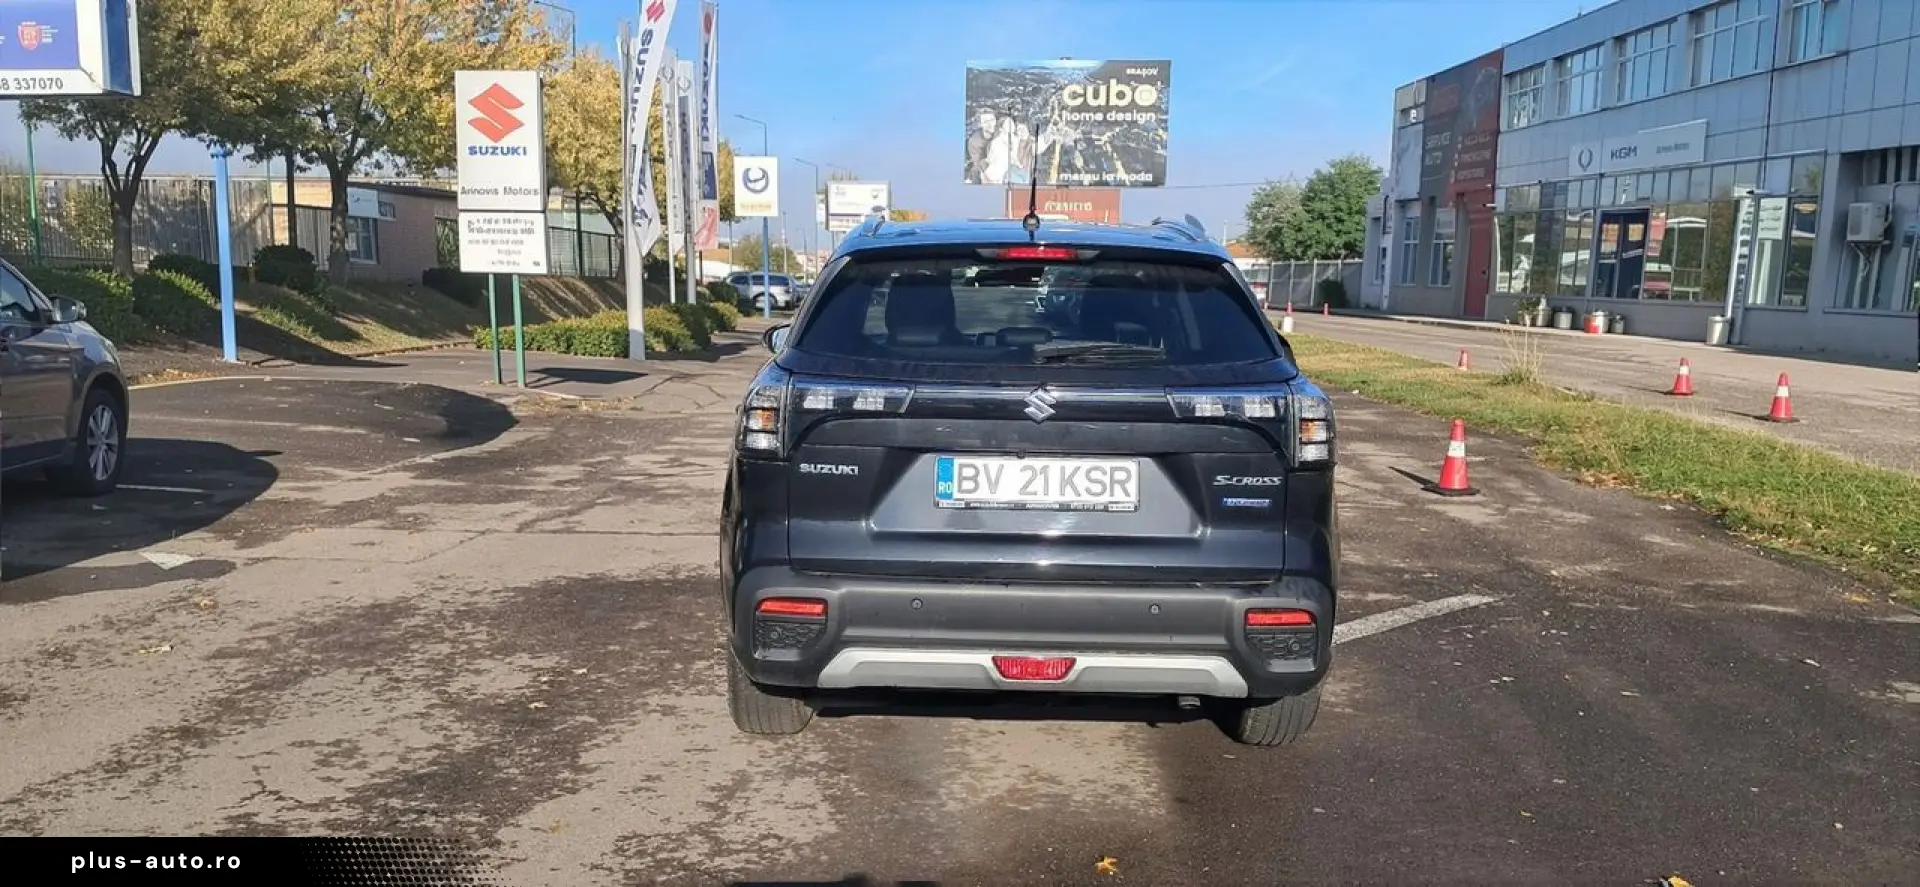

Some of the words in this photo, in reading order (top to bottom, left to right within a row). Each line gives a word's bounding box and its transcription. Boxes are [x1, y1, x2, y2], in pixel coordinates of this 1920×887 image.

[13, 77, 63, 90] 337070
[1063, 78, 1157, 107] cubo
[1061, 110, 1104, 122] home
[1106, 110, 1156, 123] design
[468, 145, 527, 156] SUZUKI
[1610, 145, 1638, 160] KGM
[503, 185, 540, 195] Motors
[799, 463, 859, 475] SUZUKI
[938, 482, 953, 494] RO
[956, 463, 1004, 495] BV
[1019, 465, 1049, 496] 21
[1059, 466, 1132, 498] KSR
[1212, 475, 1283, 486] S-CROSS
